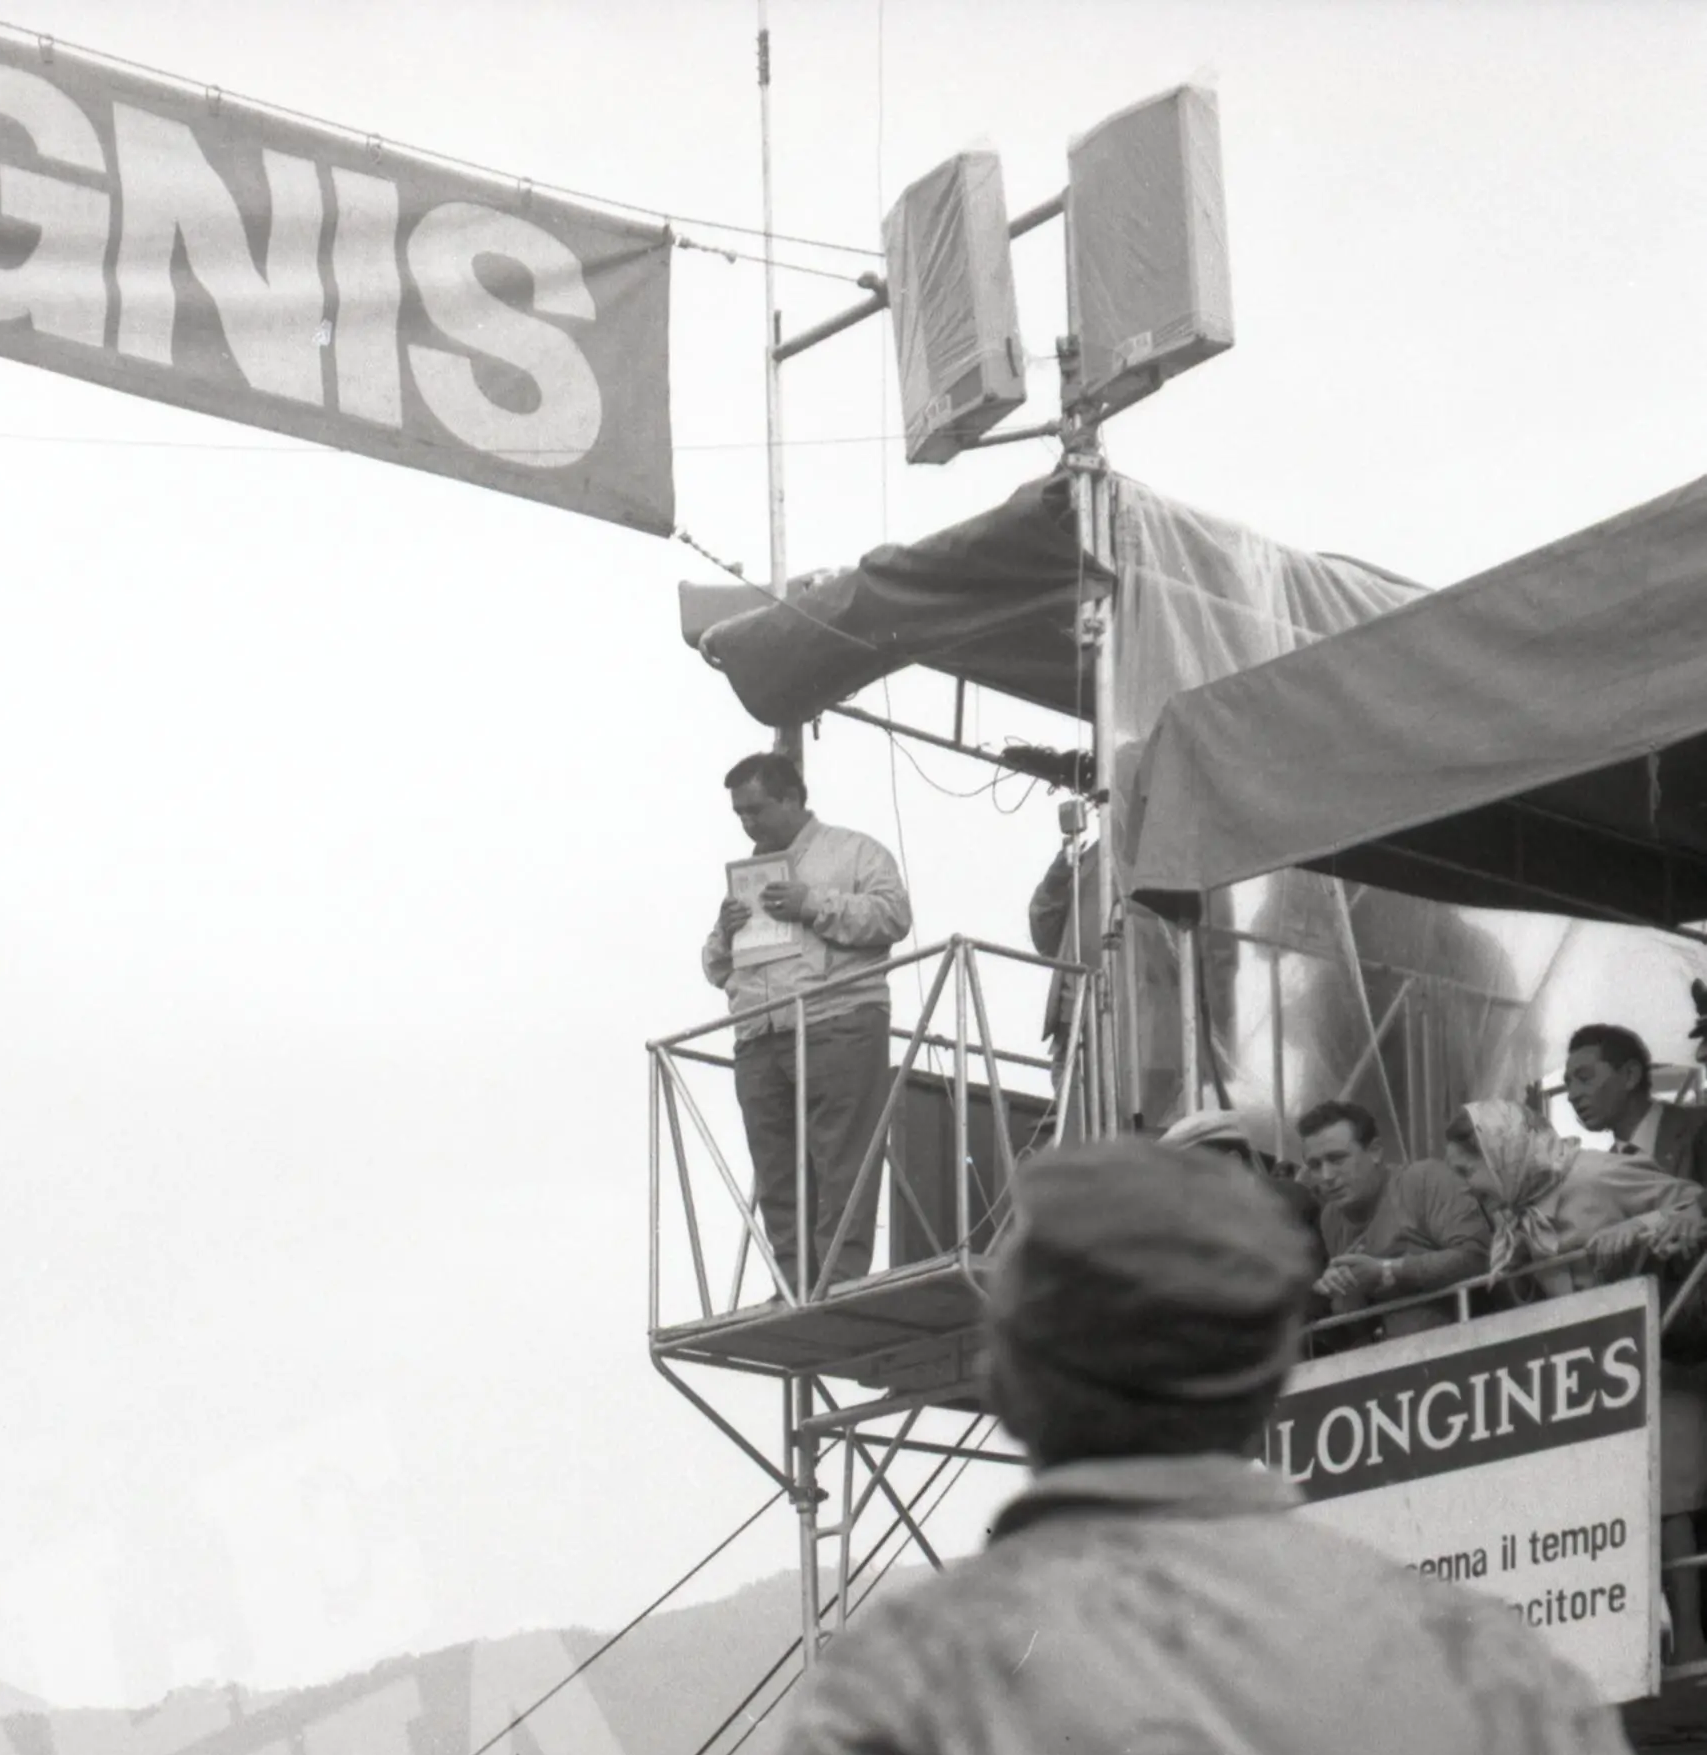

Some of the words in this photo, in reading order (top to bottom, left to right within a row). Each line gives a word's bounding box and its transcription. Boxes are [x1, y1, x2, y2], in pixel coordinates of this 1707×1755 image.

[1277, 1336, 1642, 1484] LONGINES
[1501, 1534, 1517, 1571] il
[1528, 1518, 1627, 1566] tempo
